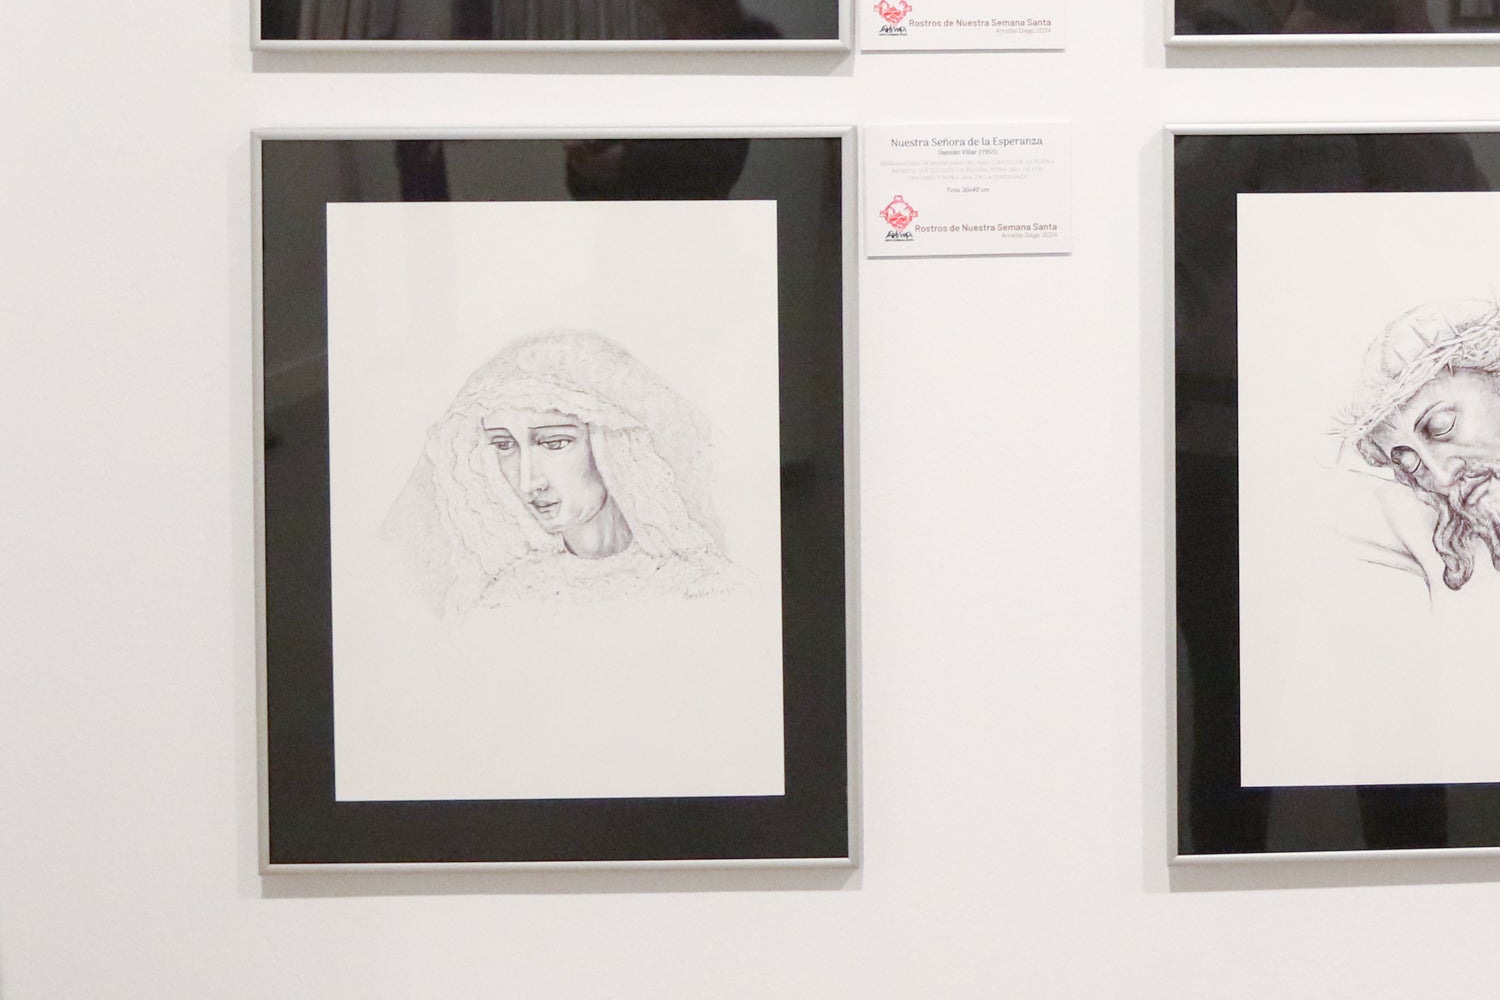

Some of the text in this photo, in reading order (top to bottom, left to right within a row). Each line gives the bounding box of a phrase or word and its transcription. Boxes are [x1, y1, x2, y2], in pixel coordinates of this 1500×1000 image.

[909, 18, 1051, 27] Rostros de Nuestra Semana Santa
[891, 137, 1043, 147] Nuestra Señora de la Esperanza
[915, 223, 1057, 233] Rostros de Nuestra Semana Santa
